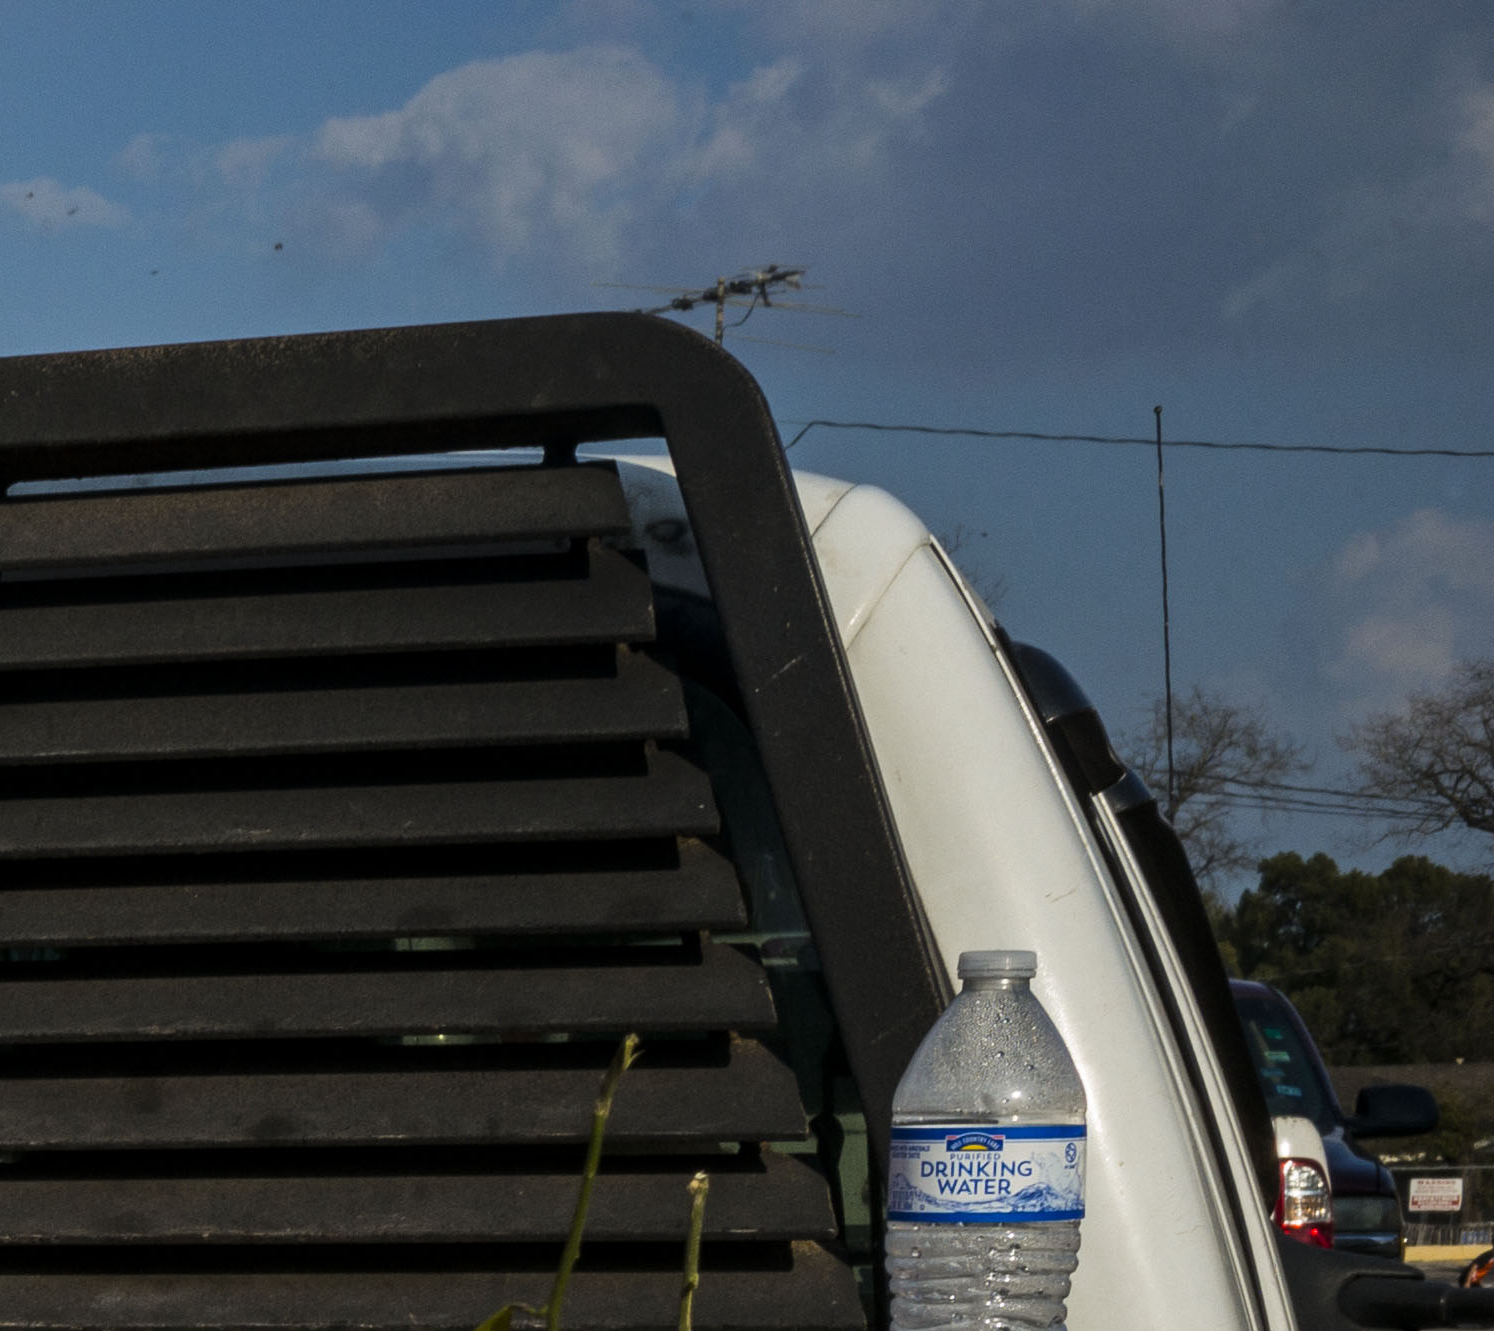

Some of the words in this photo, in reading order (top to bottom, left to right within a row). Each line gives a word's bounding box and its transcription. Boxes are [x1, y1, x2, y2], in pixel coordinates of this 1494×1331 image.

[950, 1153, 1001, 1161] PURIFIED
[920, 1160, 1033, 1178] DRINKING
[937, 1179, 1012, 1196] WATER
